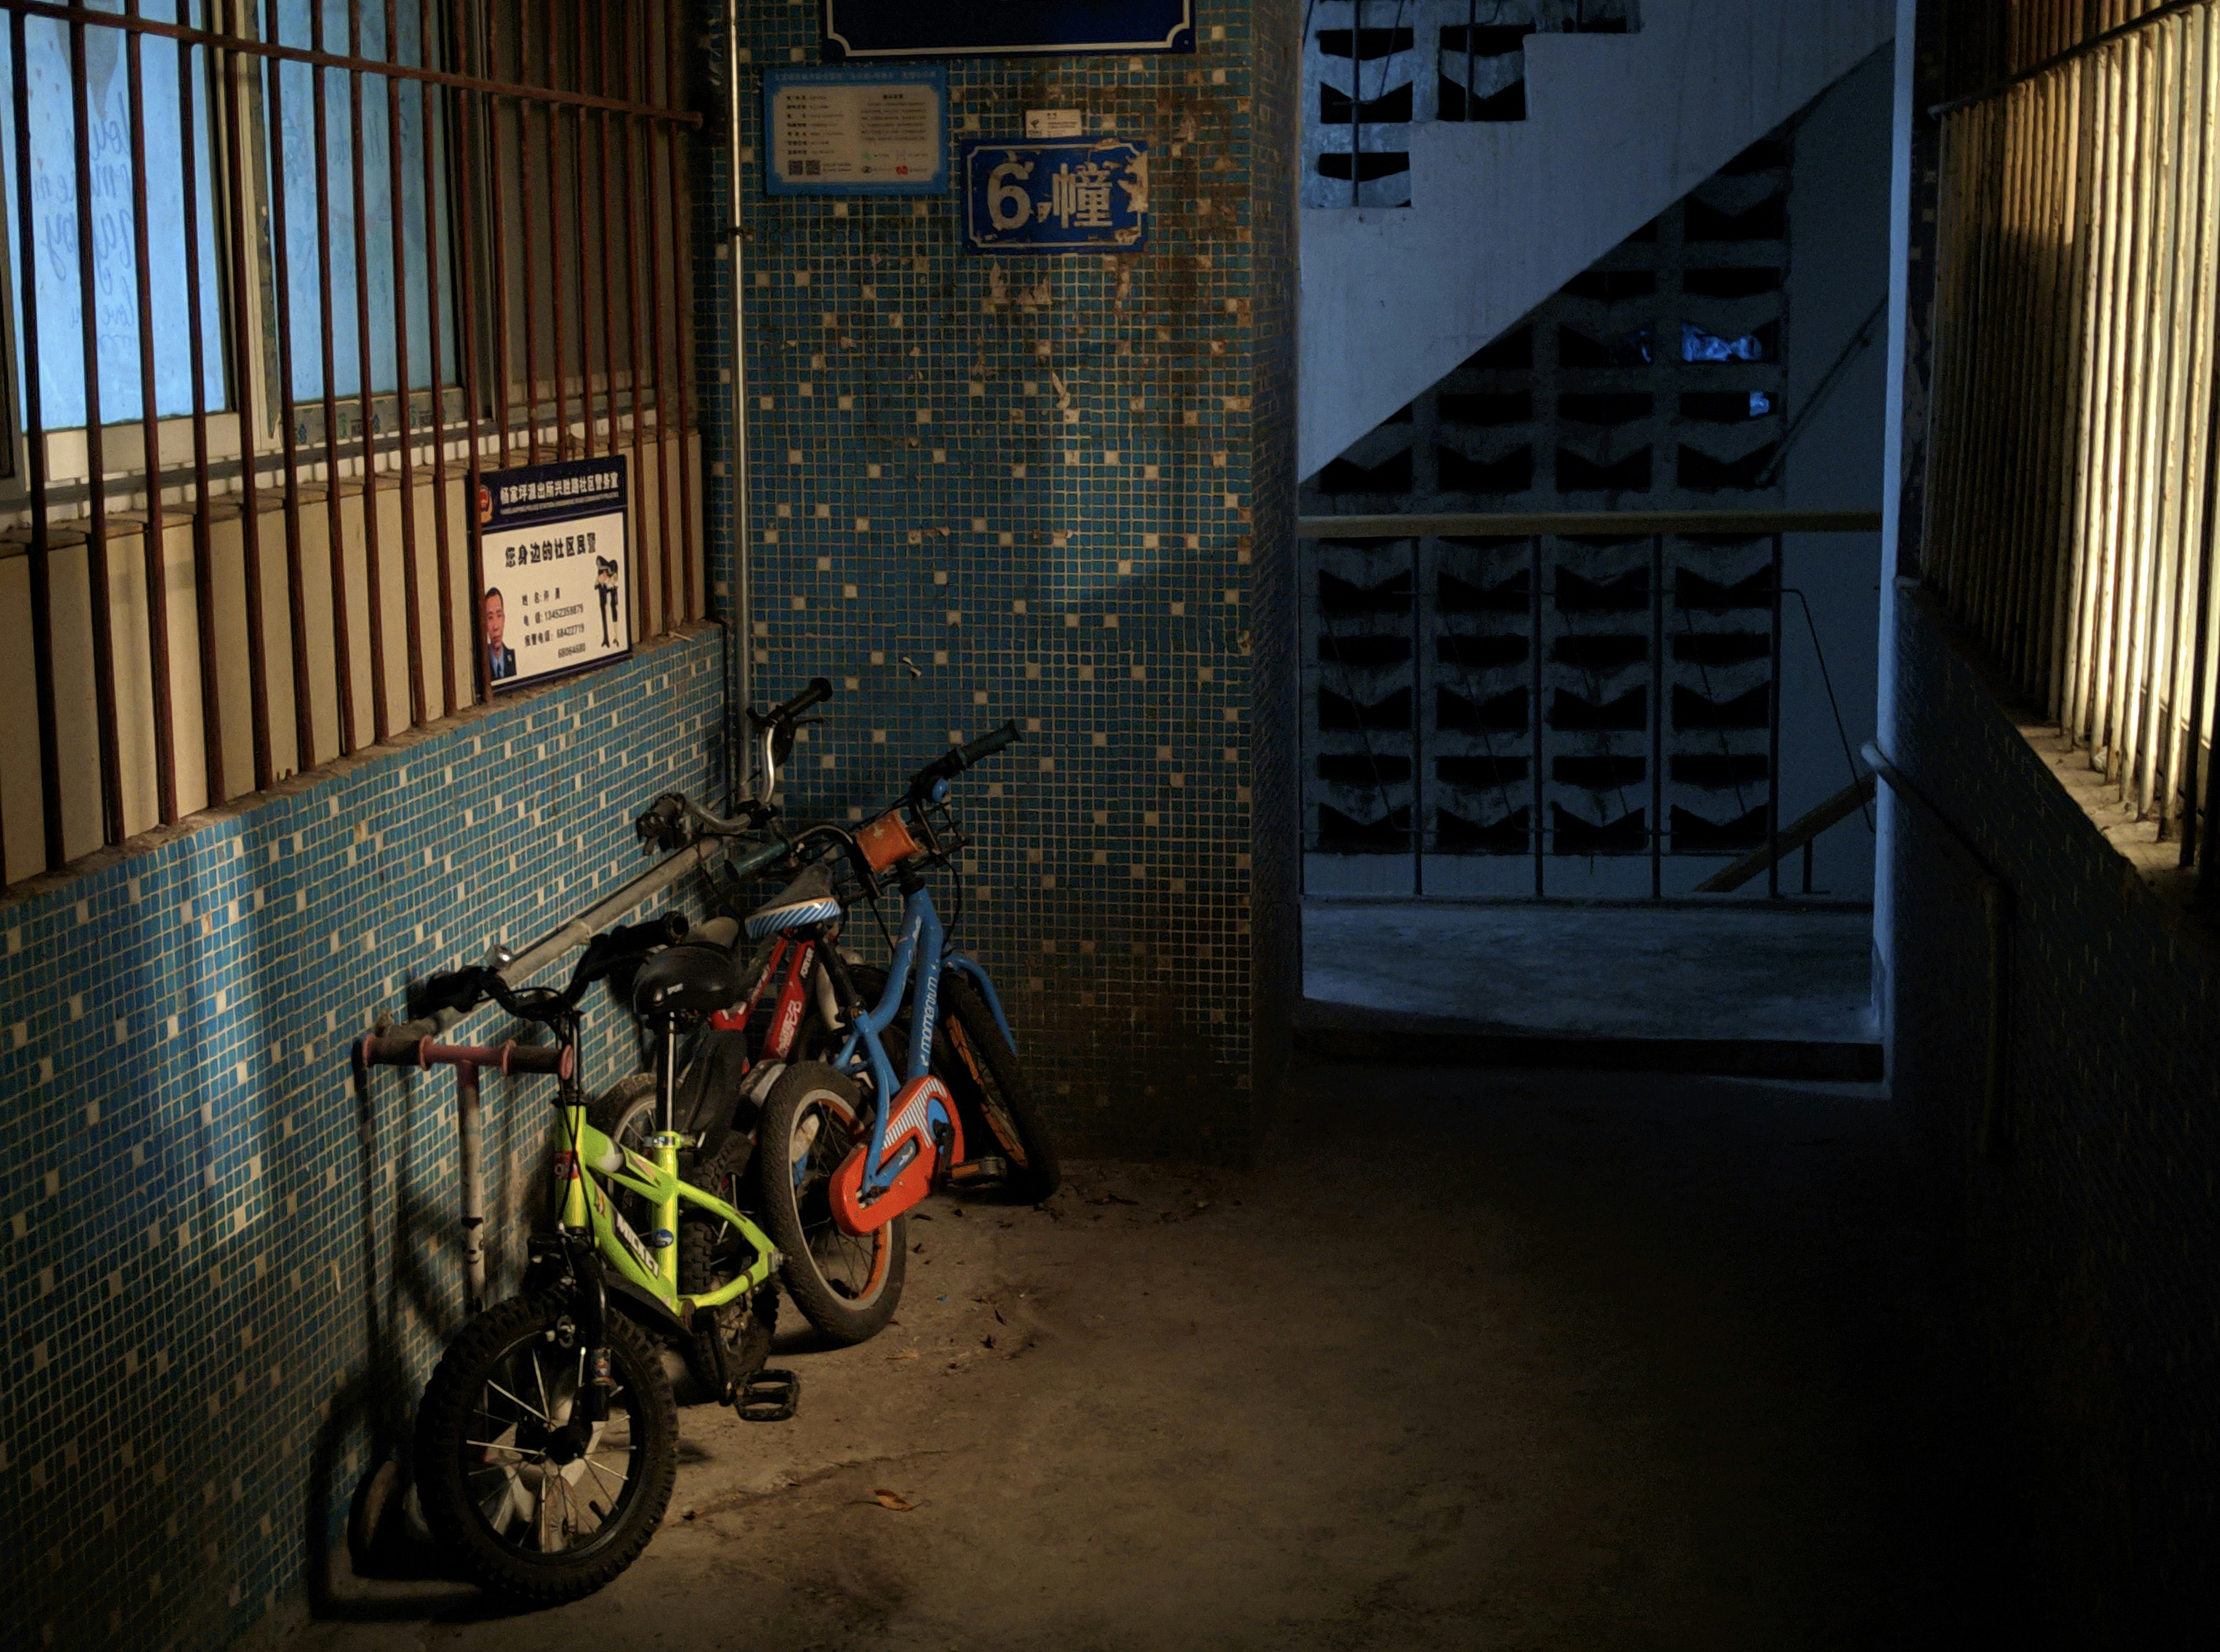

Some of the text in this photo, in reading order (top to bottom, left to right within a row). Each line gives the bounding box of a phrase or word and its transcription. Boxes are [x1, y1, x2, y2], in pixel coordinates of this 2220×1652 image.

[505, 532, 596, 568] 您身边的社区民警
[920, 976, 938, 1055] momentum
